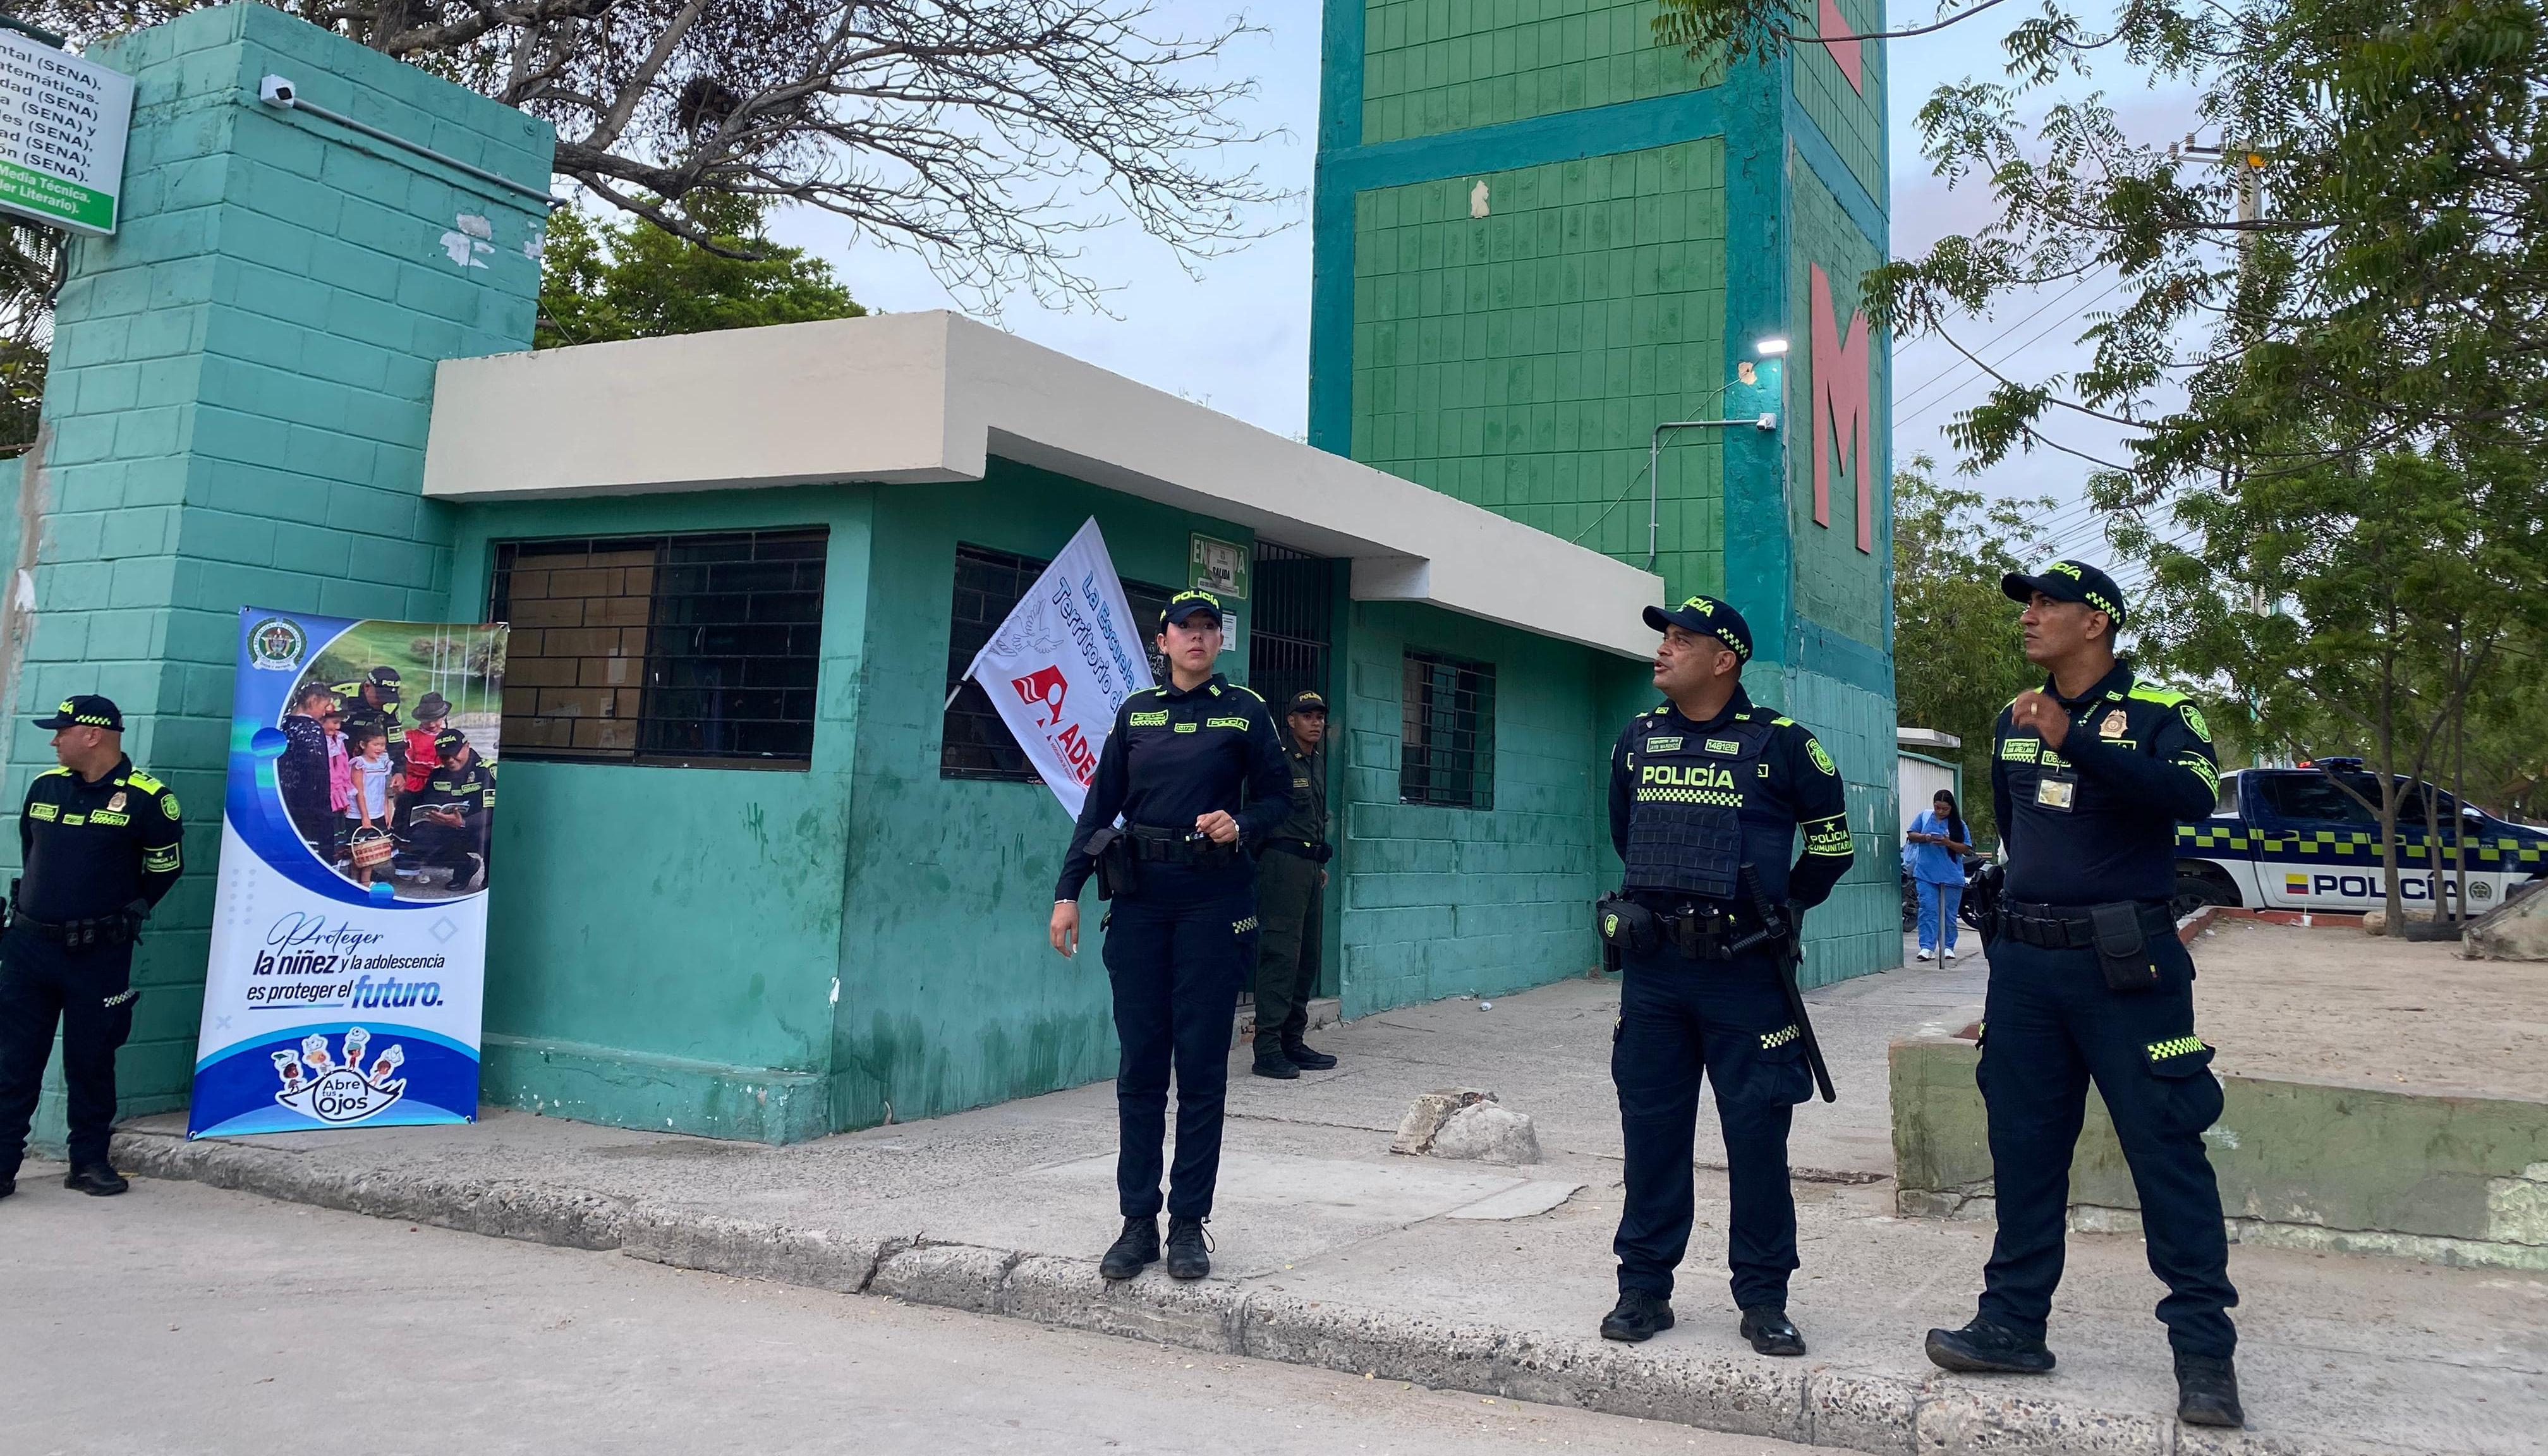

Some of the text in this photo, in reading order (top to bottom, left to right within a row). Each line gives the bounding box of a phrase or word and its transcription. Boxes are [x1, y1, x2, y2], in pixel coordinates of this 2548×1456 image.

[37, 58, 101, 90] (SENA),
[21, 101, 83, 132] (SENA)
[87, 126, 97, 136] y
[39, 91, 98, 122] (SENA)
[0, 109, 93, 152] es (SENA),
[26, 136, 90, 167] (SENA),
[23, 152, 88, 183] (SENA).
[19, 184, 80, 215] Literario).
[39, 176, 91, 203] Técnica.
[1811, 261, 1871, 555] M
[1172, 590, 1219, 610] POLICÍA
[1052, 576, 1112, 695] Territorio
[1082, 570, 1135, 693] La Escuela
[1642, 762, 1735, 789] POLICÍA
[1810, 830, 1848, 844] POLICIA
[2314, 871, 2458, 900] POLCÍA
[267, 911, 384, 956] Proteger
[253, 949, 445, 975] la niñez y la adolescencia
[247, 974, 444, 1009] es proteger el futuro.
[323, 1079, 360, 1091] Abre
[318, 1093, 368, 1115] Ojos
